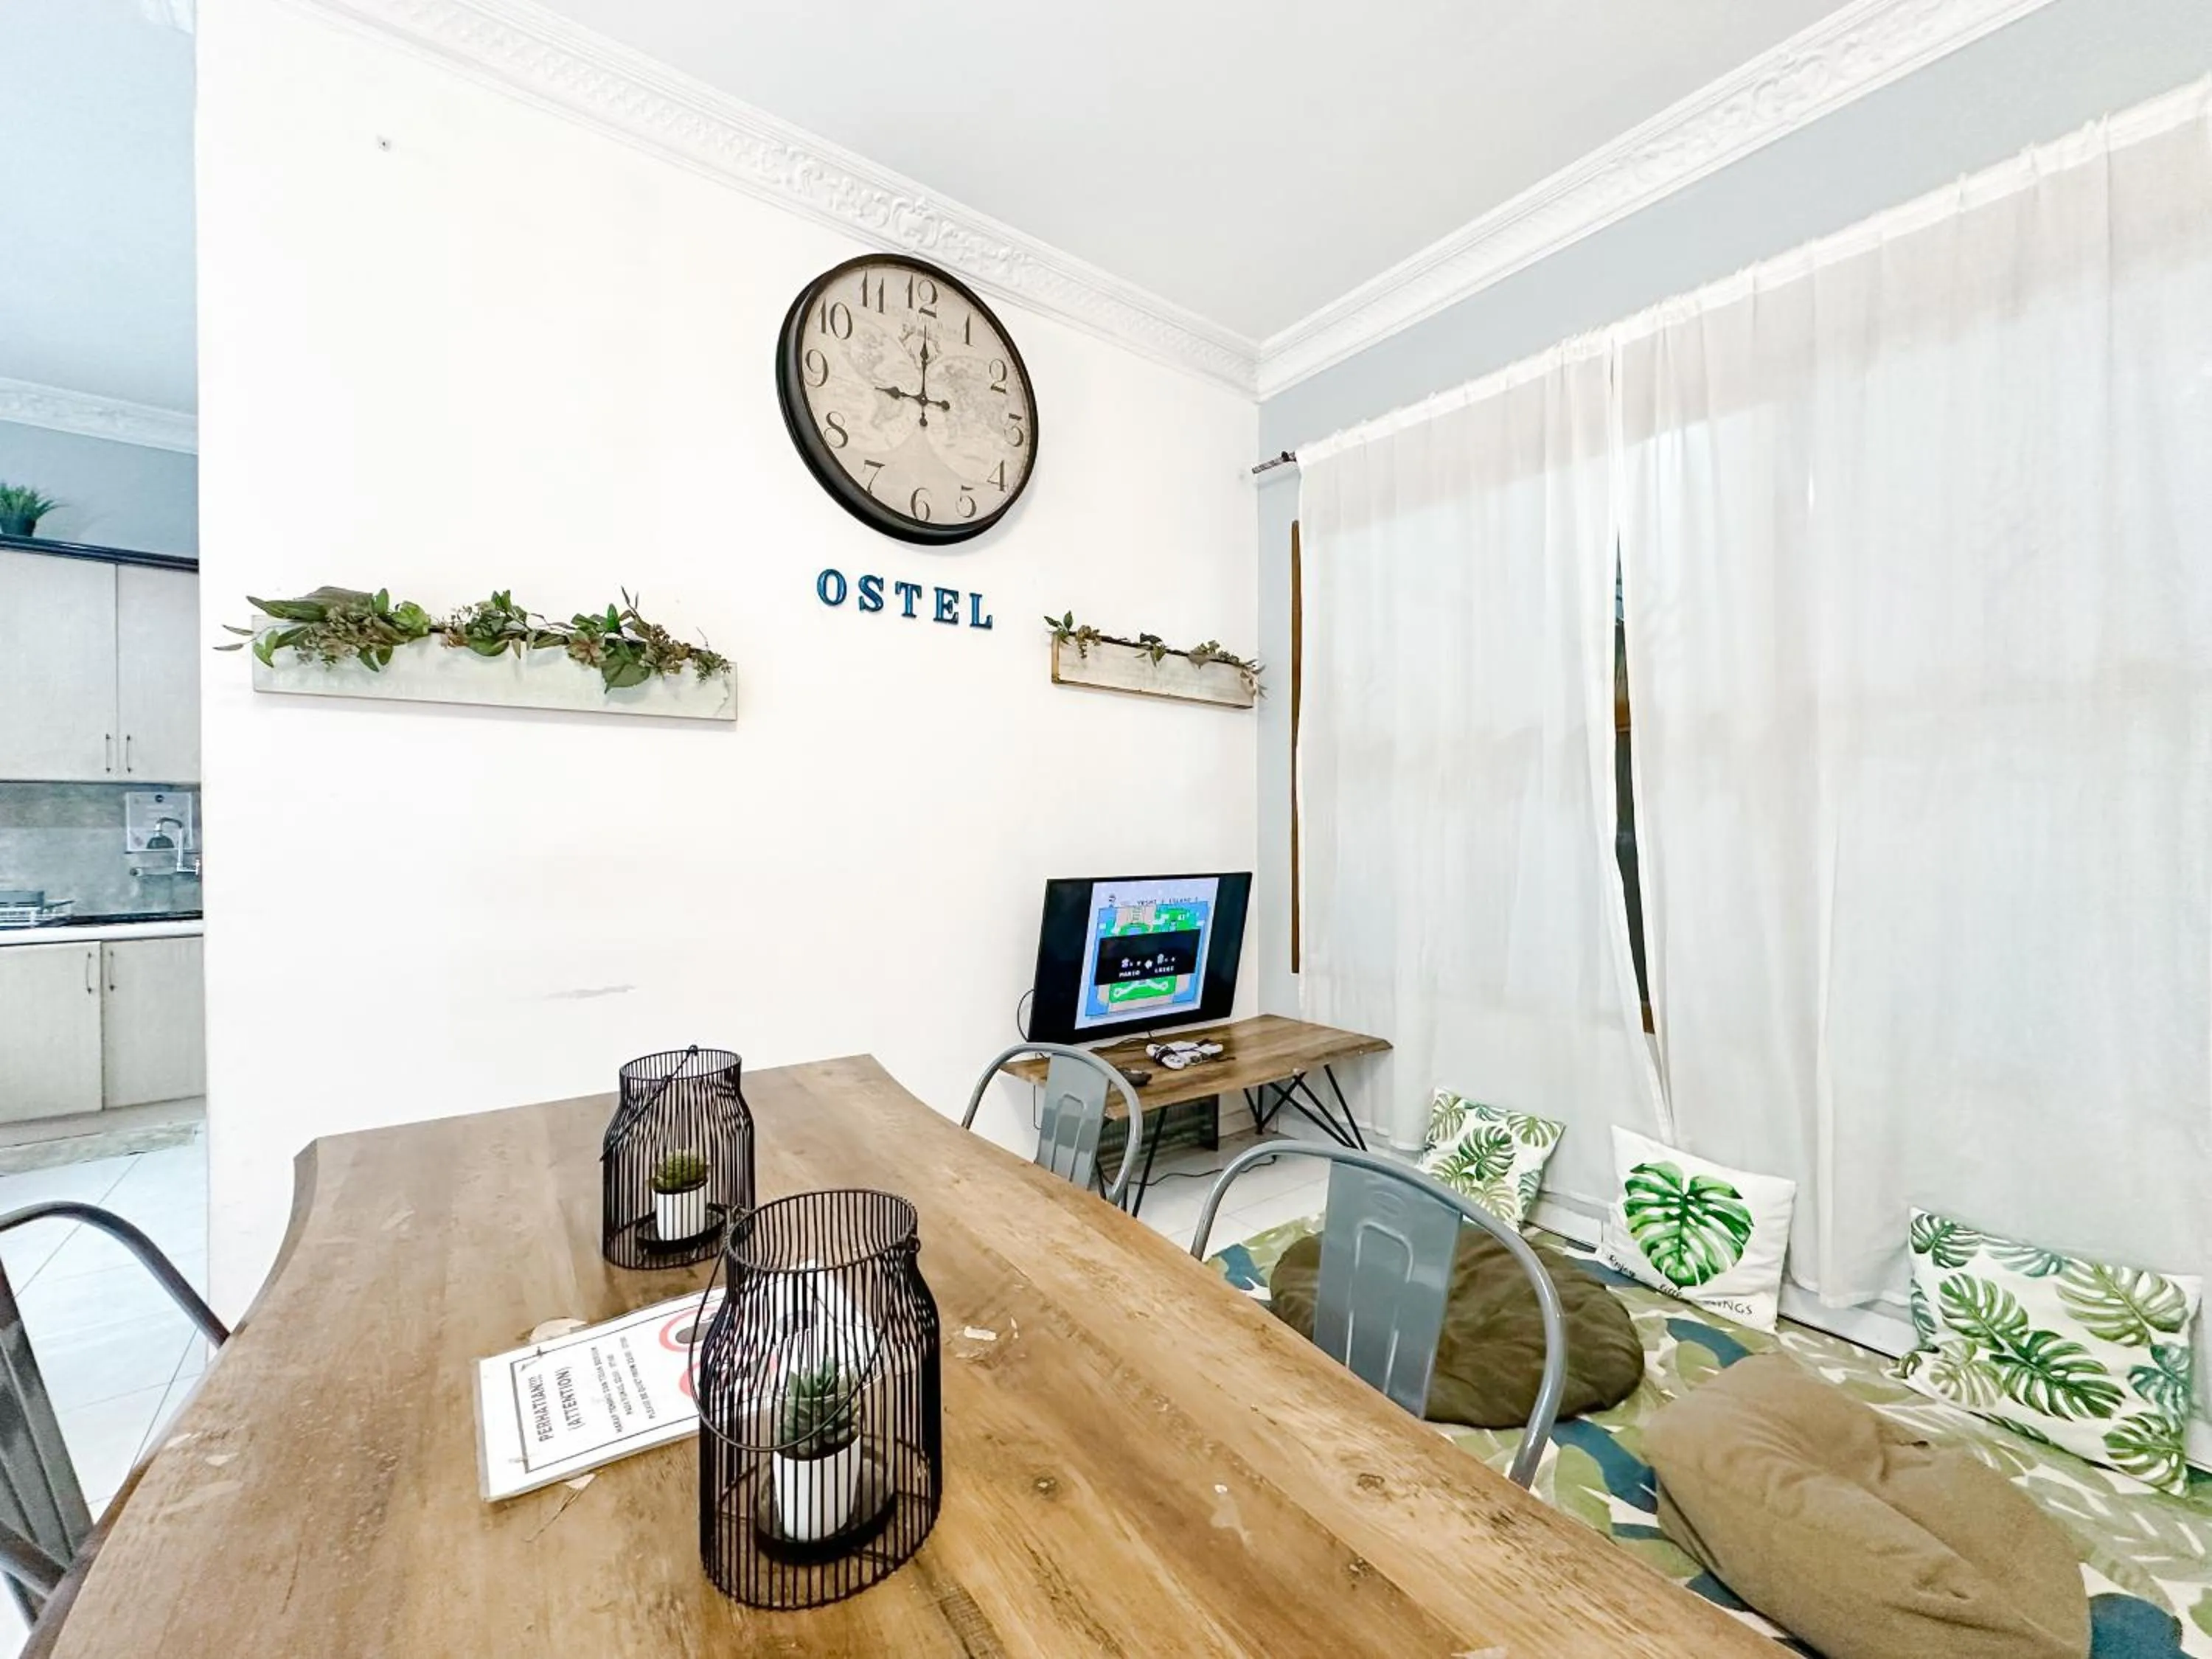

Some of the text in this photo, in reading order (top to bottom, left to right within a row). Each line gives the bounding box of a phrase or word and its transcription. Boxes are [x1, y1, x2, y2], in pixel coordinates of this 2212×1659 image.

[860, 270, 885, 313] 11
[905, 274, 939, 319] 12
[820, 298, 853, 340] 10
[963, 312, 974, 347] 1
[804, 349, 829, 388] 9
[989, 358, 1007, 394] 2
[824, 411, 849, 449] 8
[1004, 413, 1023, 448] 3
[863, 459, 886, 494] 7
[987, 459, 1009, 493] 4
[911, 487, 932, 522] 6
[956, 485, 976, 518] 5
[816, 568, 993, 630] OSTEL
[554, 1366, 586, 1431] (ATTENTION)
